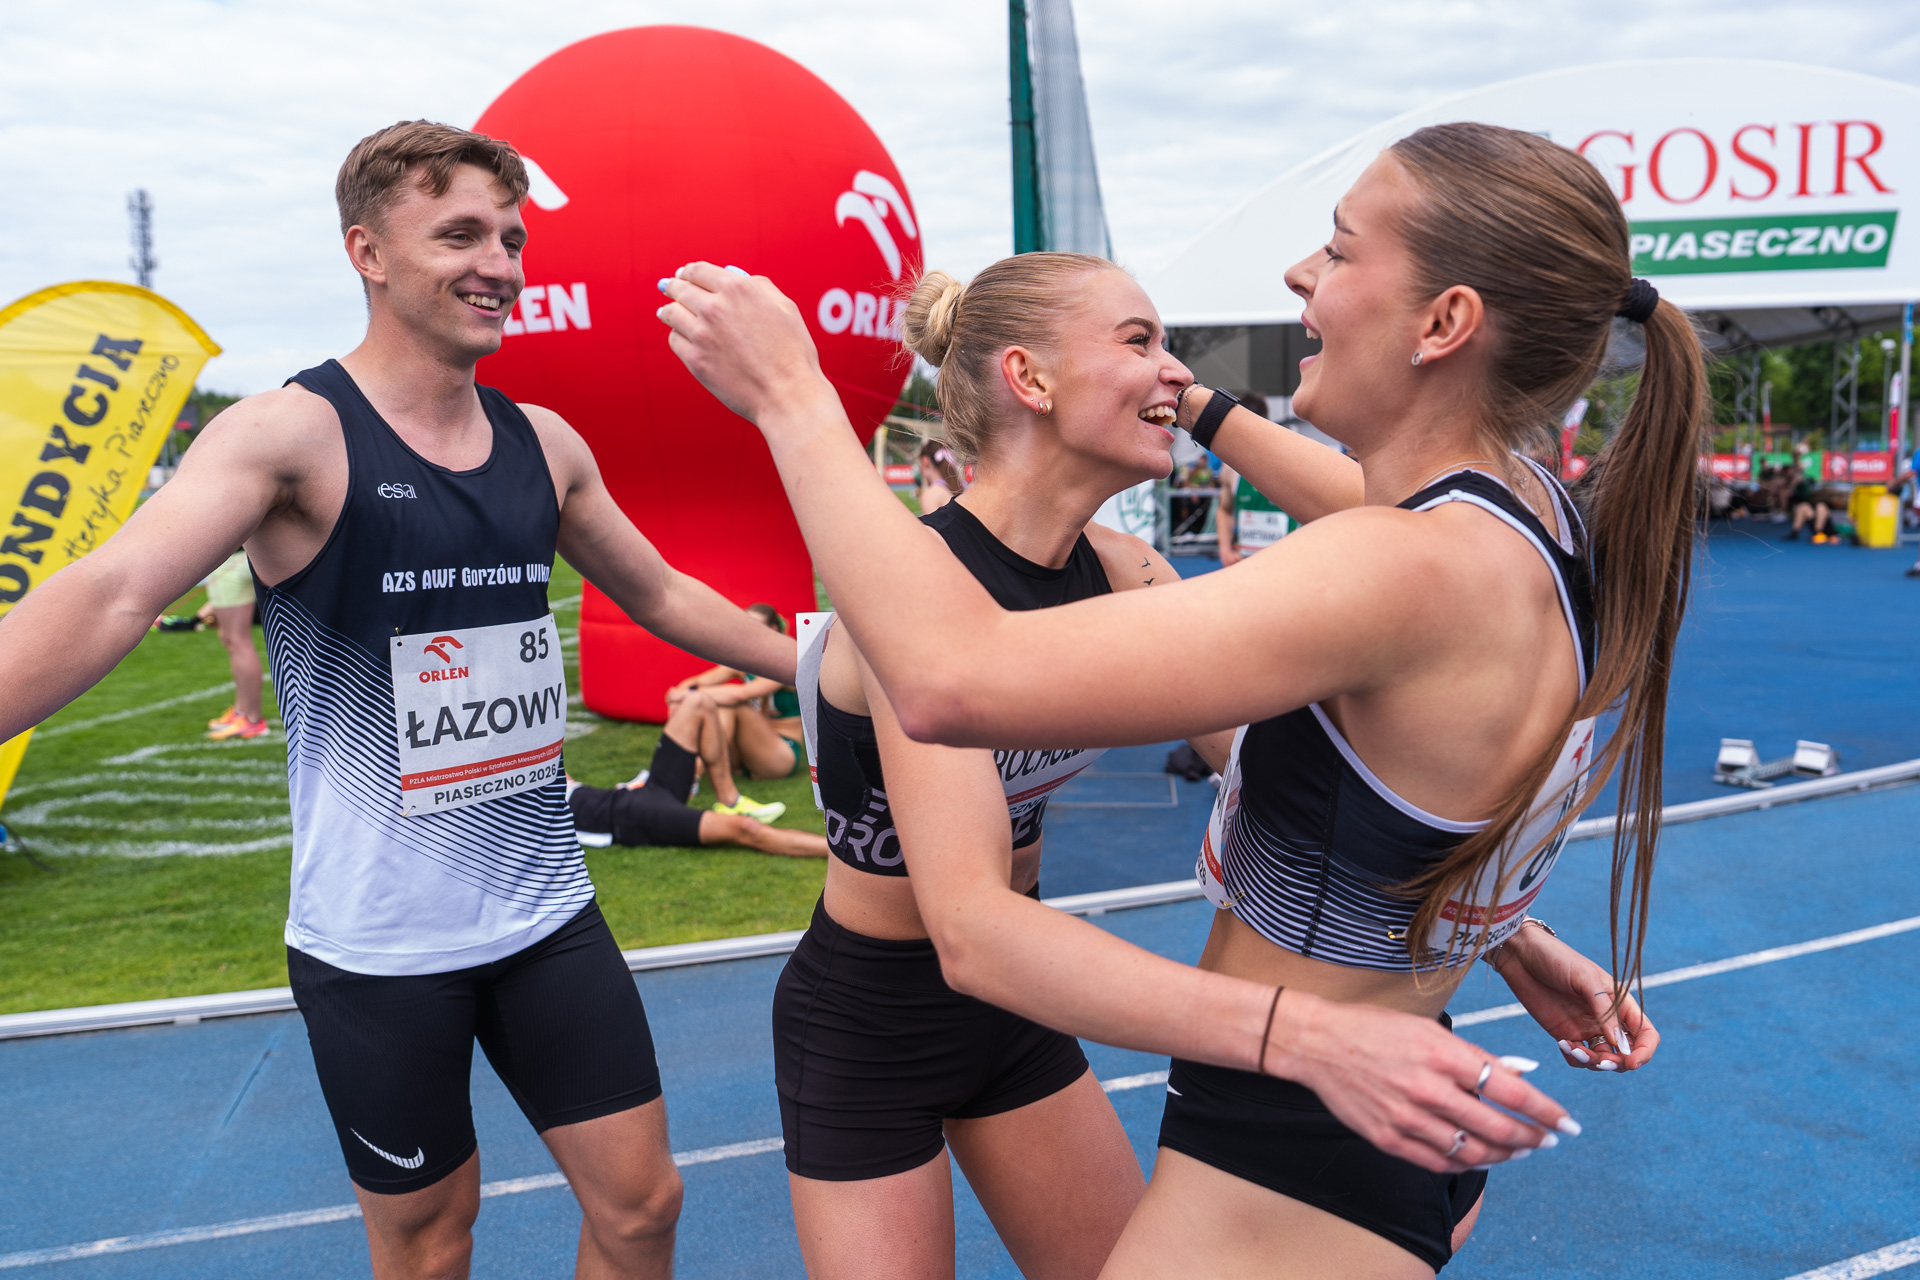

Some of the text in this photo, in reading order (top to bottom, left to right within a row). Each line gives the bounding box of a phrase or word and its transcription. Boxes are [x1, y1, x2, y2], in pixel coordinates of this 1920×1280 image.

[1576, 119, 1899, 205] GOSIR
[1630, 223, 1889, 262] PIASECZNO
[382, 571, 416, 593] AZS
[422, 567, 456, 590] AWF
[461, 563, 522, 587] Gorzów
[519, 627, 549, 663] 85
[418, 666, 469, 684] ORLEN
[405, 682, 562, 749] ŁAZOWY
[409, 777, 426, 785] PZLA
[426, 770, 464, 783] Mistrzostwa
[464, 766, 482, 776] Polski
[488, 759, 517, 770] Sztafetach
[517, 752, 547, 764] Mieszanych
[434, 763, 557, 805] PIASECZNO 2026
